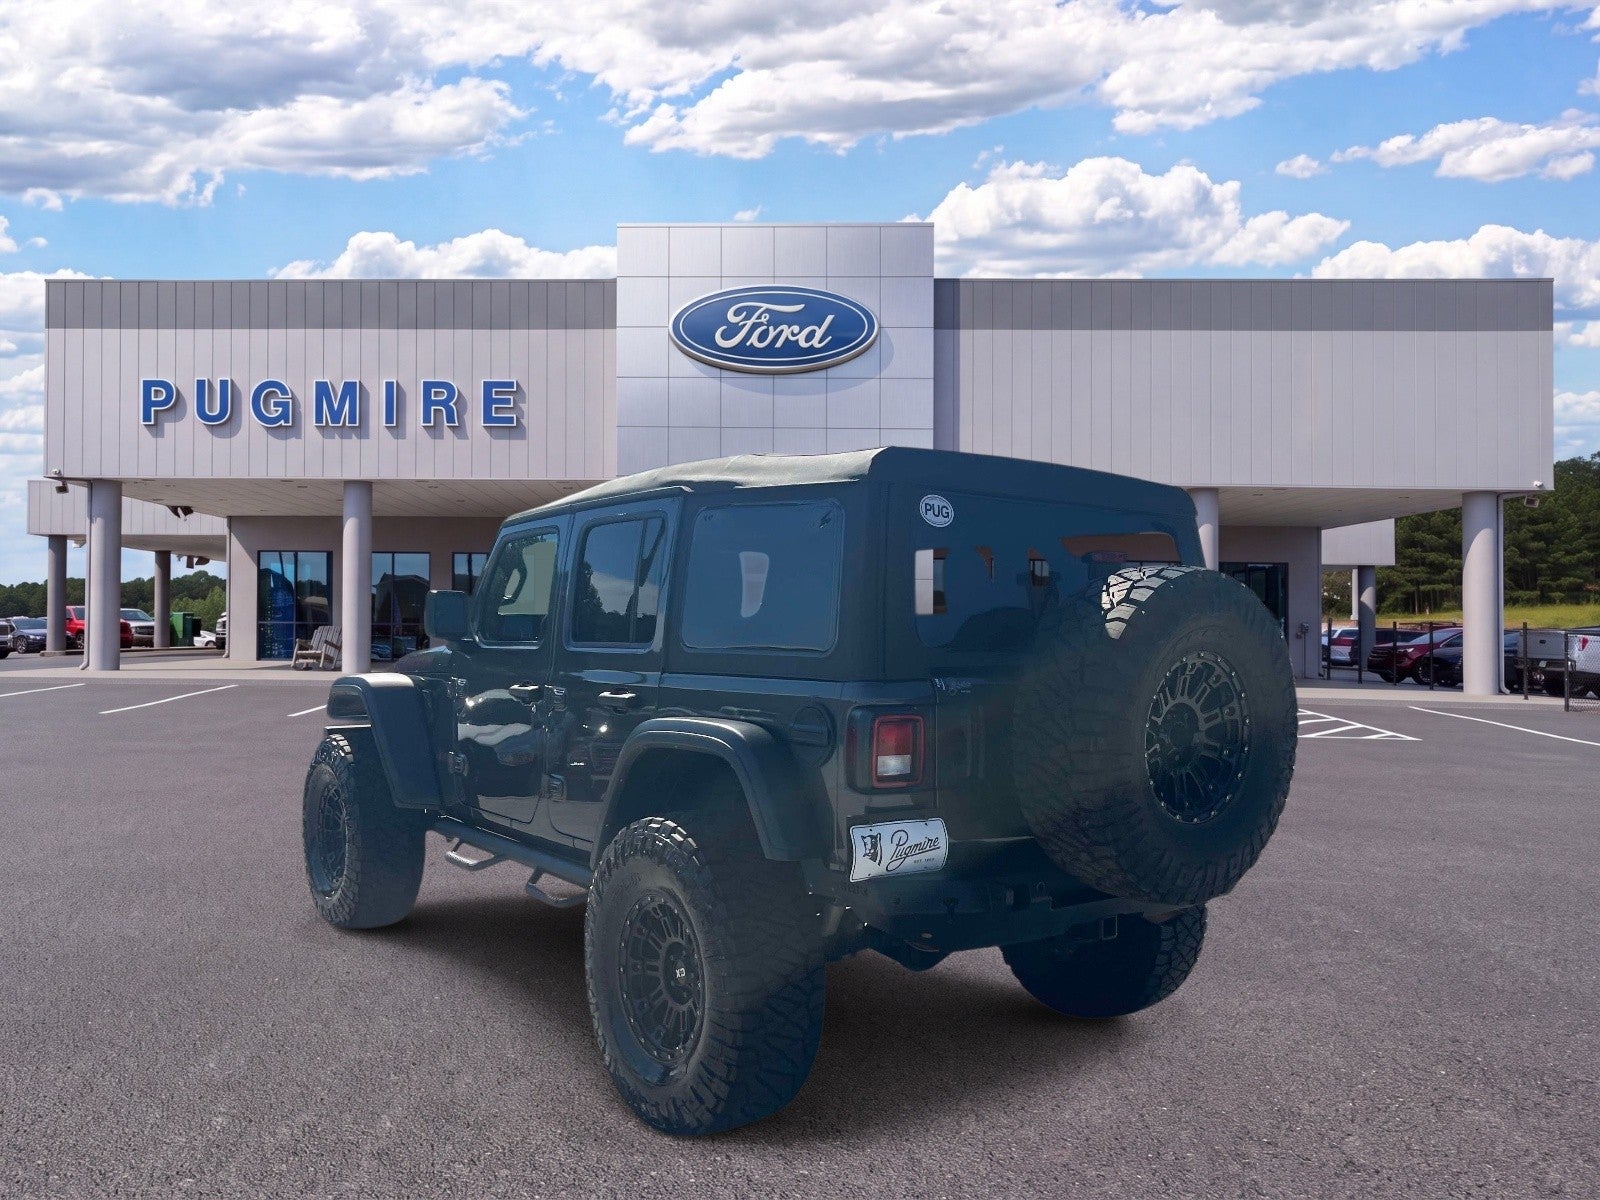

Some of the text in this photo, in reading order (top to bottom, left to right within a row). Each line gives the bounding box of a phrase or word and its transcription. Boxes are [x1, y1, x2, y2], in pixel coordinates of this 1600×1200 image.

[714, 301, 835, 349] Ford
[140, 377, 518, 427] PUGMIRE
[924, 502, 950, 519] PUG
[886, 829, 941, 872] Pugmire
